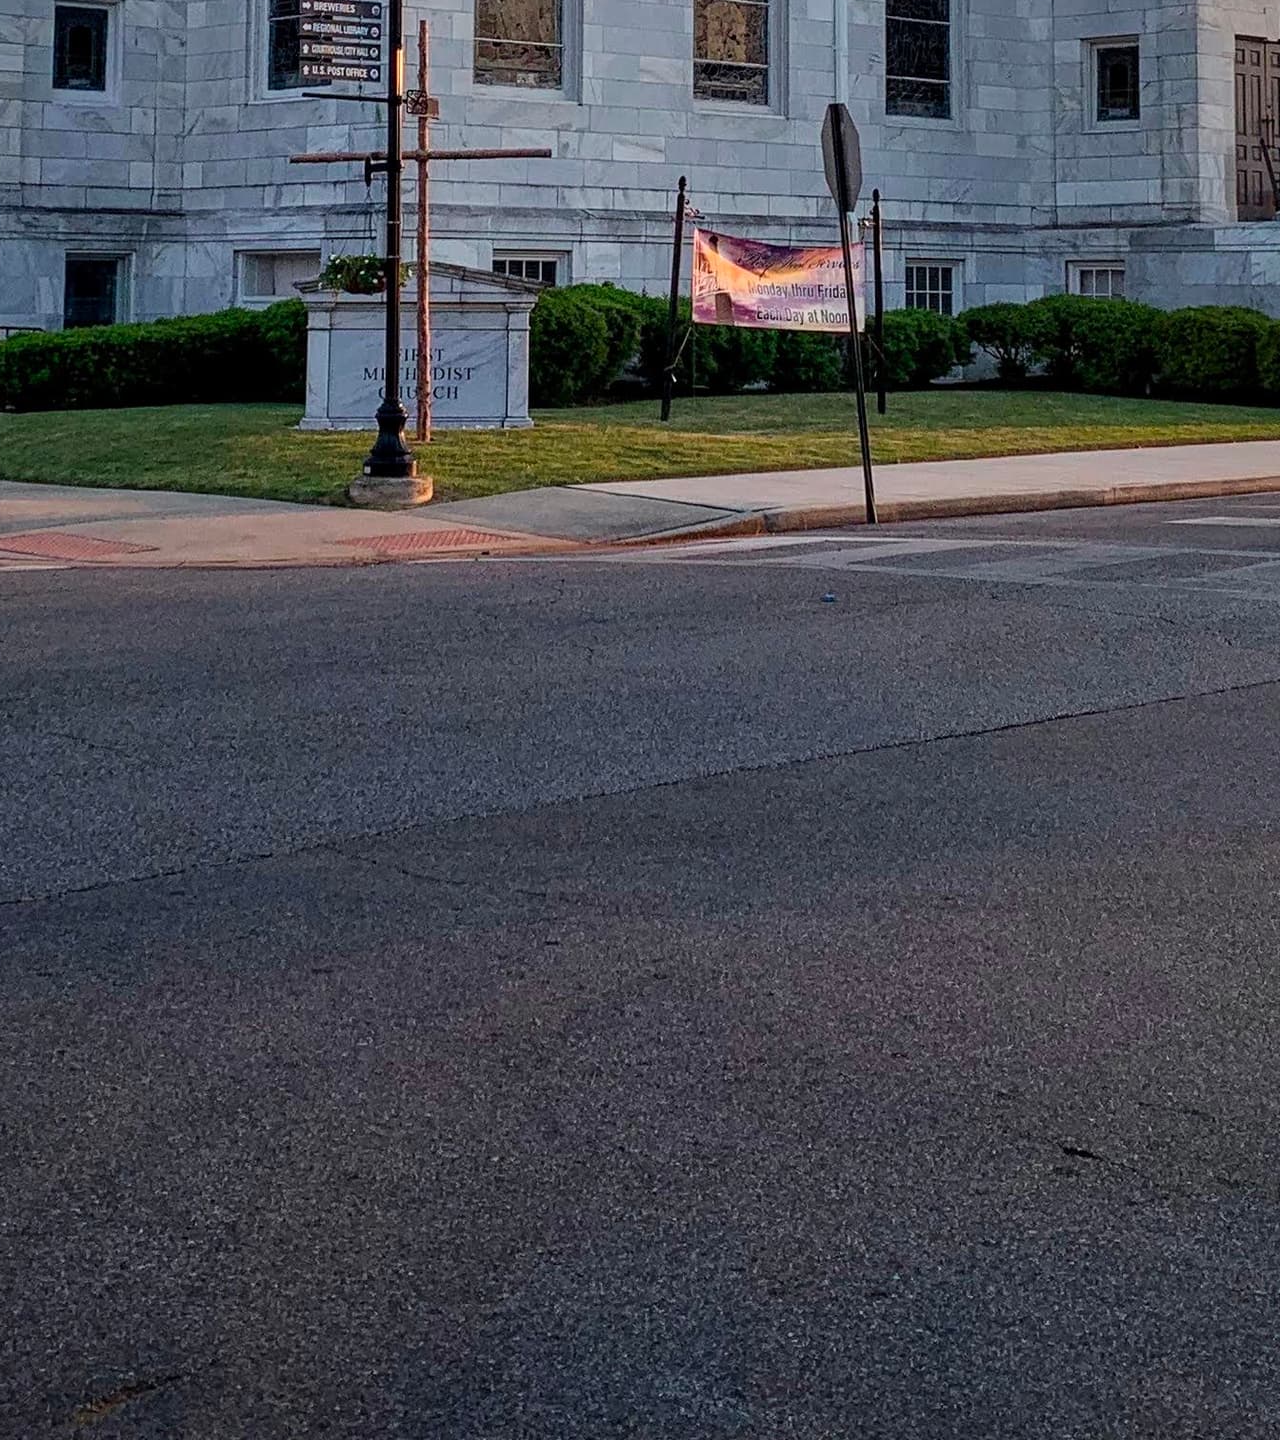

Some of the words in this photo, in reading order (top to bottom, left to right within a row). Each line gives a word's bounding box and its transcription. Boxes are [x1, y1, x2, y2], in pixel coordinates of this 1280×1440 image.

[313, 1, 356, 13] BREWERIES
[312, 22, 343, 34] REGIONAL
[344, 25, 369, 36] LIBRARY
[312, 65, 326, 75] U.S.
[327, 66, 345, 76] POST
[345, 67, 368, 78] OFFICE
[748, 279, 789, 299] Monday
[791, 282, 814, 298] thru
[817, 284, 847, 299] Frida
[756, 306, 783, 321] Each
[785, 309, 805, 326] Day
[807, 310, 818, 323] at
[821, 310, 849, 325] Noon
[399, 348, 445, 362] IRT
[363, 367, 476, 381] MHDIST
[378, 386, 459, 400] CUCH
